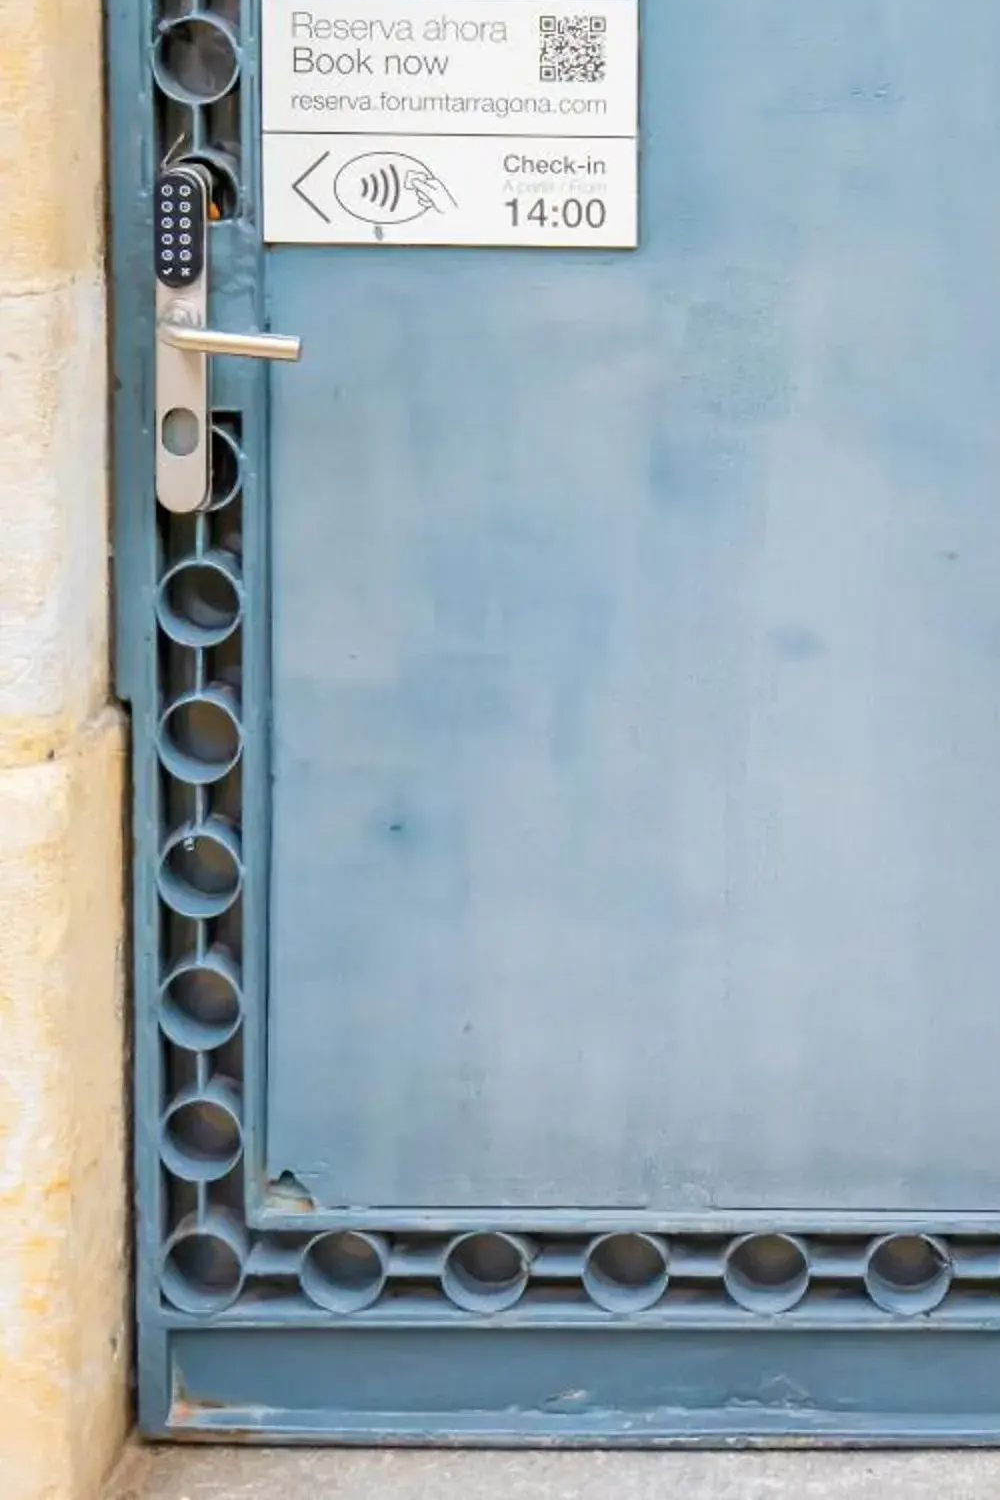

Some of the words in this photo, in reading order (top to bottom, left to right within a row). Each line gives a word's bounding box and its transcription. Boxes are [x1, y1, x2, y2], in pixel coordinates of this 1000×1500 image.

[291, 10, 414, 43] Reserva
[422, 14, 508, 43] ahora
[292, 46, 374, 76] Book
[384, 53, 449, 76] now
[290, 90, 607, 118] reserva.forumtarragona.com
[503, 153, 606, 175] Check-in
[504, 197, 606, 229] 14:00
